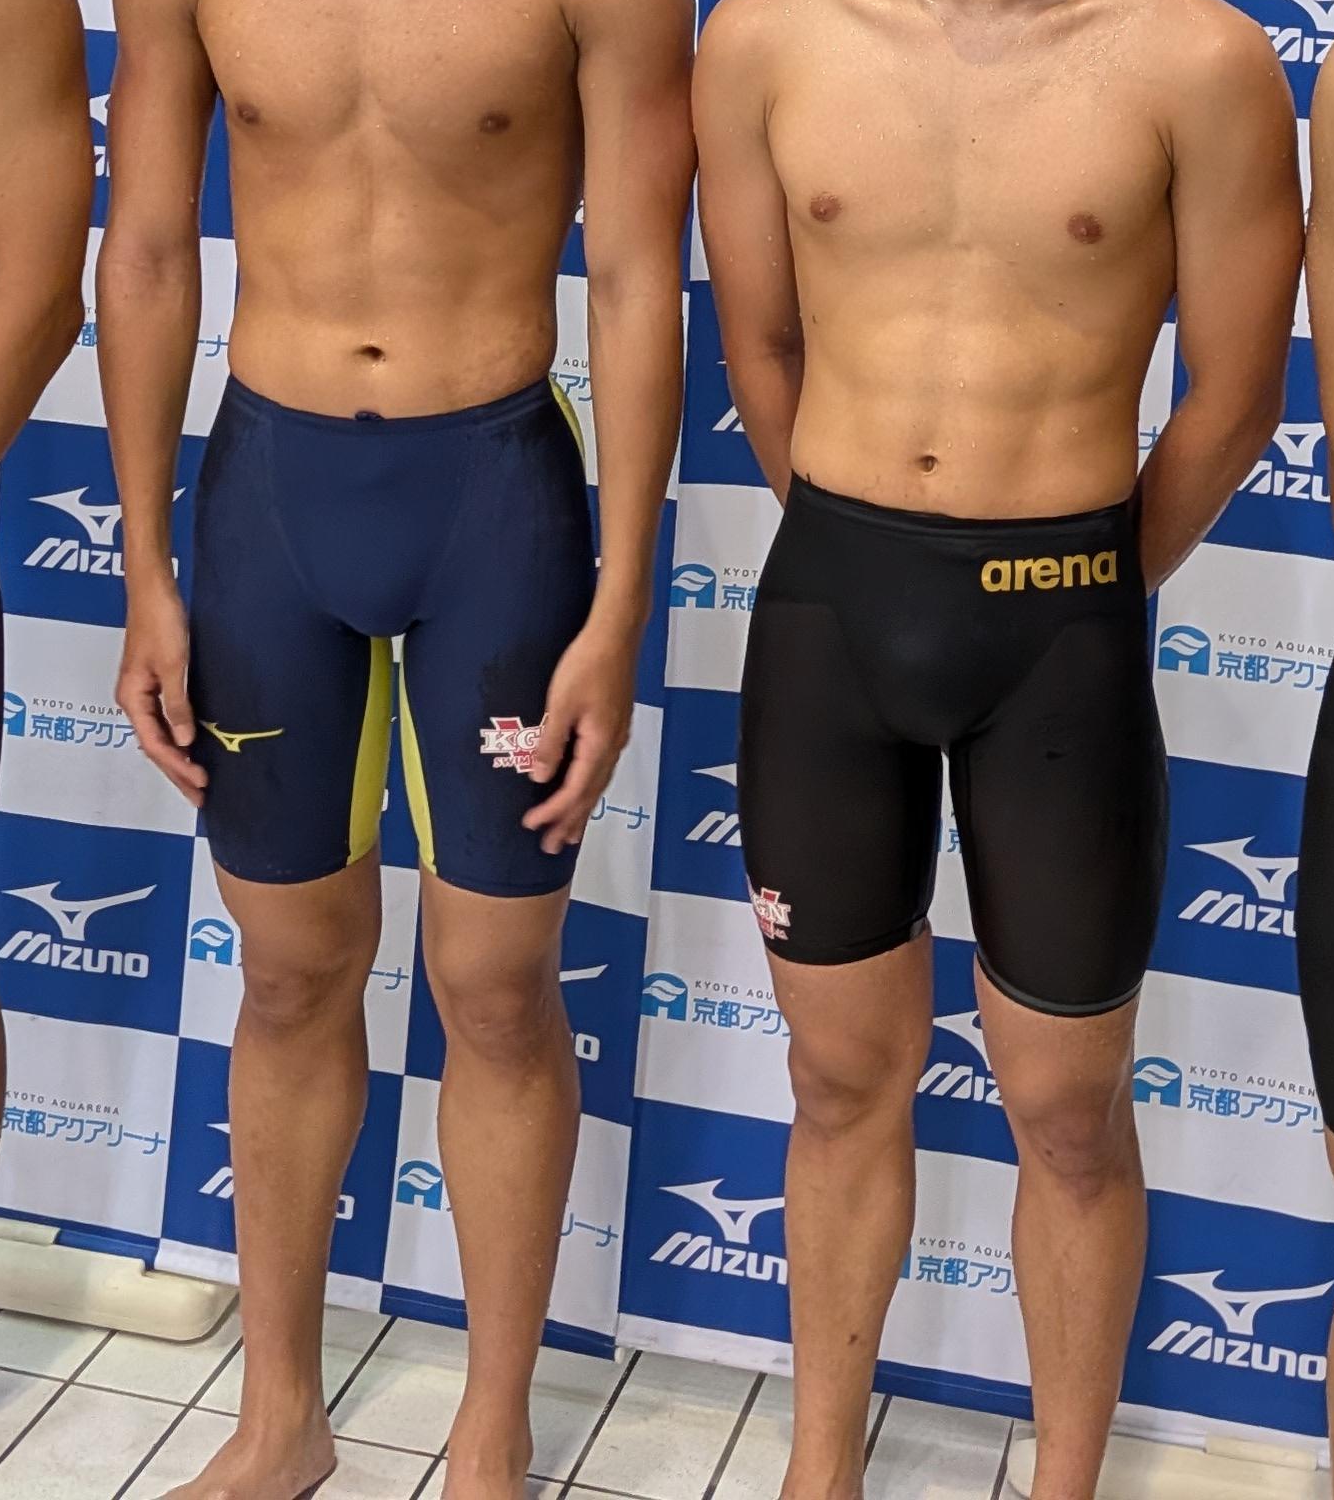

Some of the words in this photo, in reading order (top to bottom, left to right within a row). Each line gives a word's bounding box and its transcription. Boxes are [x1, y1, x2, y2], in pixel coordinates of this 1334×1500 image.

[723, 567, 760, 579] KYOT
[981, 550, 1117, 592] arena
[1218, 632, 1267, 645] KYOTO
[1275, 640, 1334, 658] AQUARE
[33, 698, 73, 711] KYOTO
[80, 703, 123, 716] AQUAR
[31, 713, 141, 749] 京都アクア
[479, 726, 541, 754] KG
[695, 979, 740, 997] KYOTO
[693, 998, 788, 1037] 京都アク
[1189, 1065, 1237, 1082] KYOTO
[1246, 1074, 1316, 1098] AQUAREN
[5, 1091, 45, 1104] KYOTO
[51, 1098, 120, 1116] AQUARENA
[1, 1106, 166, 1156] 京都アクアリーナ
[650, 1233, 788, 1285] MIZUN
[919, 1236, 965, 1252] KYOTO
[974, 1244, 1012, 1261] AQUA
[916, 1253, 1017, 1297] 京都アク
[1147, 1320, 1326, 1382] MIZUNO
